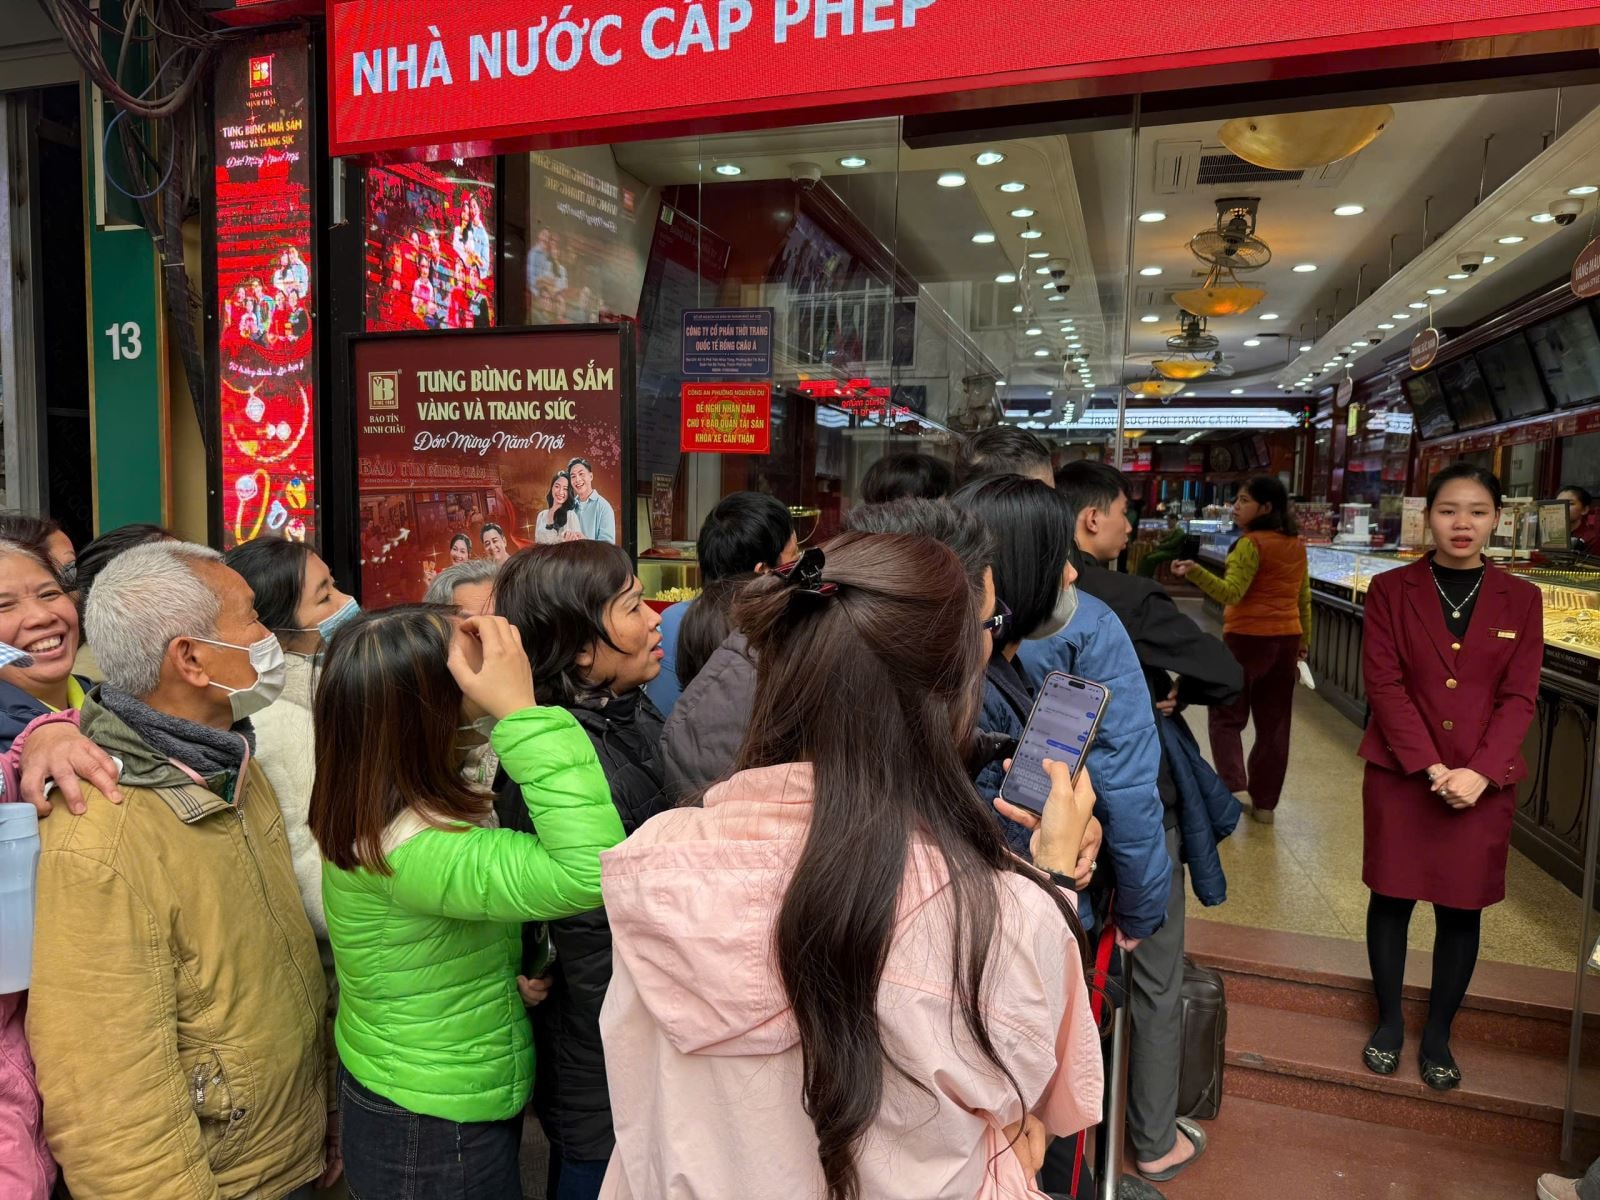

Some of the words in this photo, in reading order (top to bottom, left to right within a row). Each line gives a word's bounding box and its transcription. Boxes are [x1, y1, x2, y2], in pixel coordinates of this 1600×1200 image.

[352, 25, 453, 96] NHÀ
[469, 4, 622, 82] NƯỚC
[268, 120, 284, 133] MUA
[105, 321, 142, 360] 13
[416, 368, 466, 393] TƯNG
[470, 364, 522, 392] BỪNG
[526, 368, 569, 391] MUA
[572, 359, 614, 391] SẮM
[416, 398, 460, 421] VÀNG
[463, 397, 486, 420] VÀ
[487, 401, 541, 420] TRANG
[544, 396, 577, 420] SỨC
[1090, 417, 1120, 426] TRAN
[363, 426, 384, 435] MINH
[384, 424, 406, 435] CHÂU
[413, 430, 448, 452] Đón
[445, 431, 493, 457] Mừng
[491, 431, 531, 453] Năm
[528, 431, 566, 454] Mới
